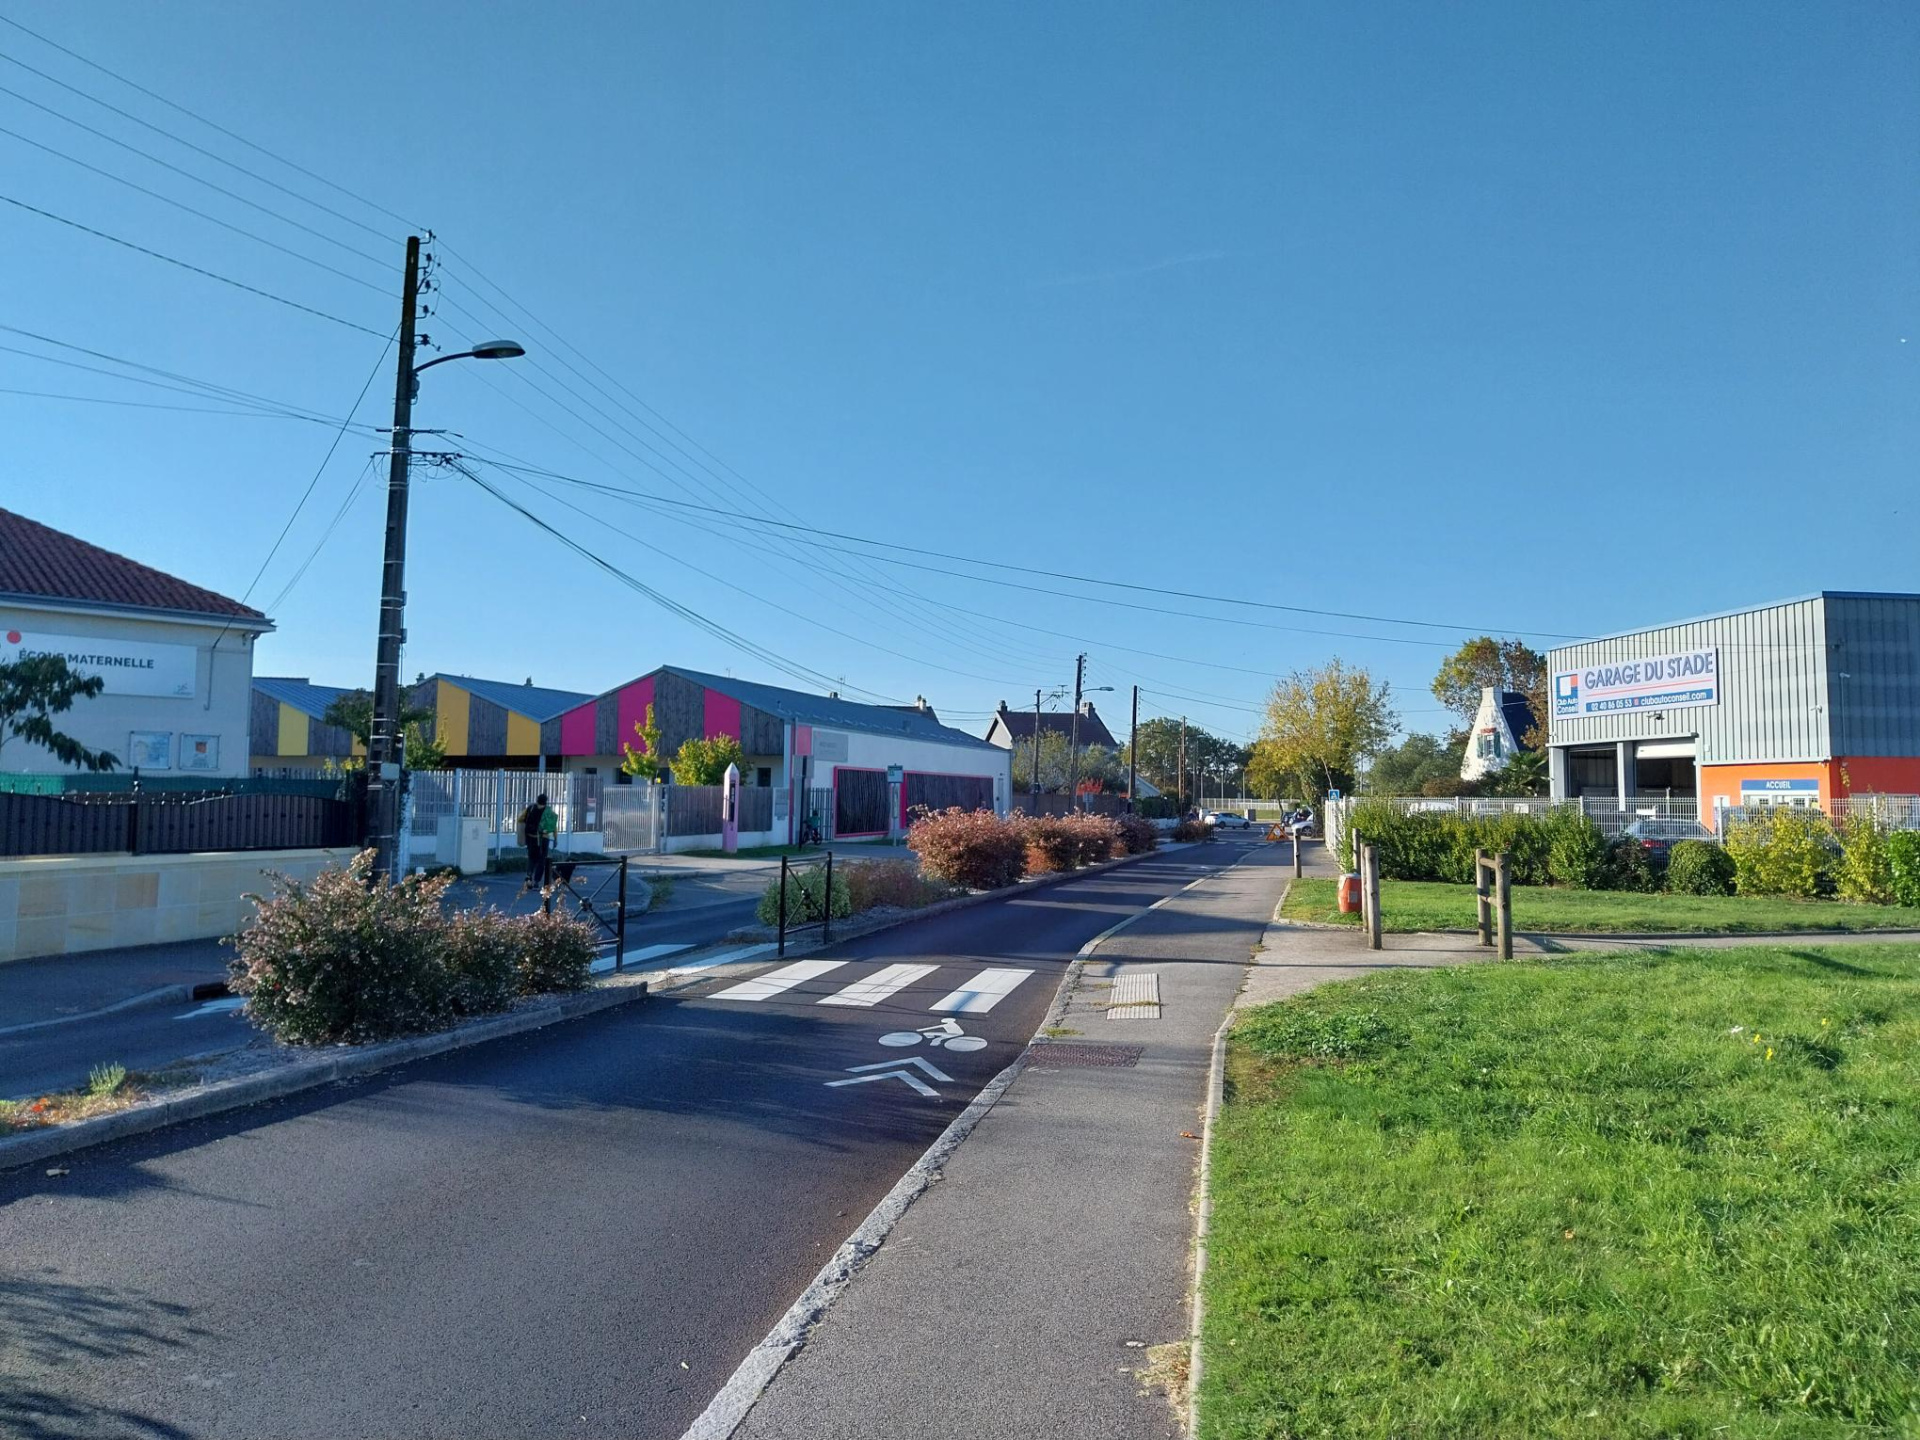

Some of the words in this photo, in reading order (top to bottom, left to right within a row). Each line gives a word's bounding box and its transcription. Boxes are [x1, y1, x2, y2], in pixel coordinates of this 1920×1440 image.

[68, 654, 154, 669] MATERNELLE
[1585, 663, 1640, 689] GARAGE
[1644, 660, 1663, 681] DU
[1667, 653, 1713, 678] STADE
[1640, 691, 1707, 706] clubautoconseil.com
[1766, 780, 1791, 789] ACCUEIL
